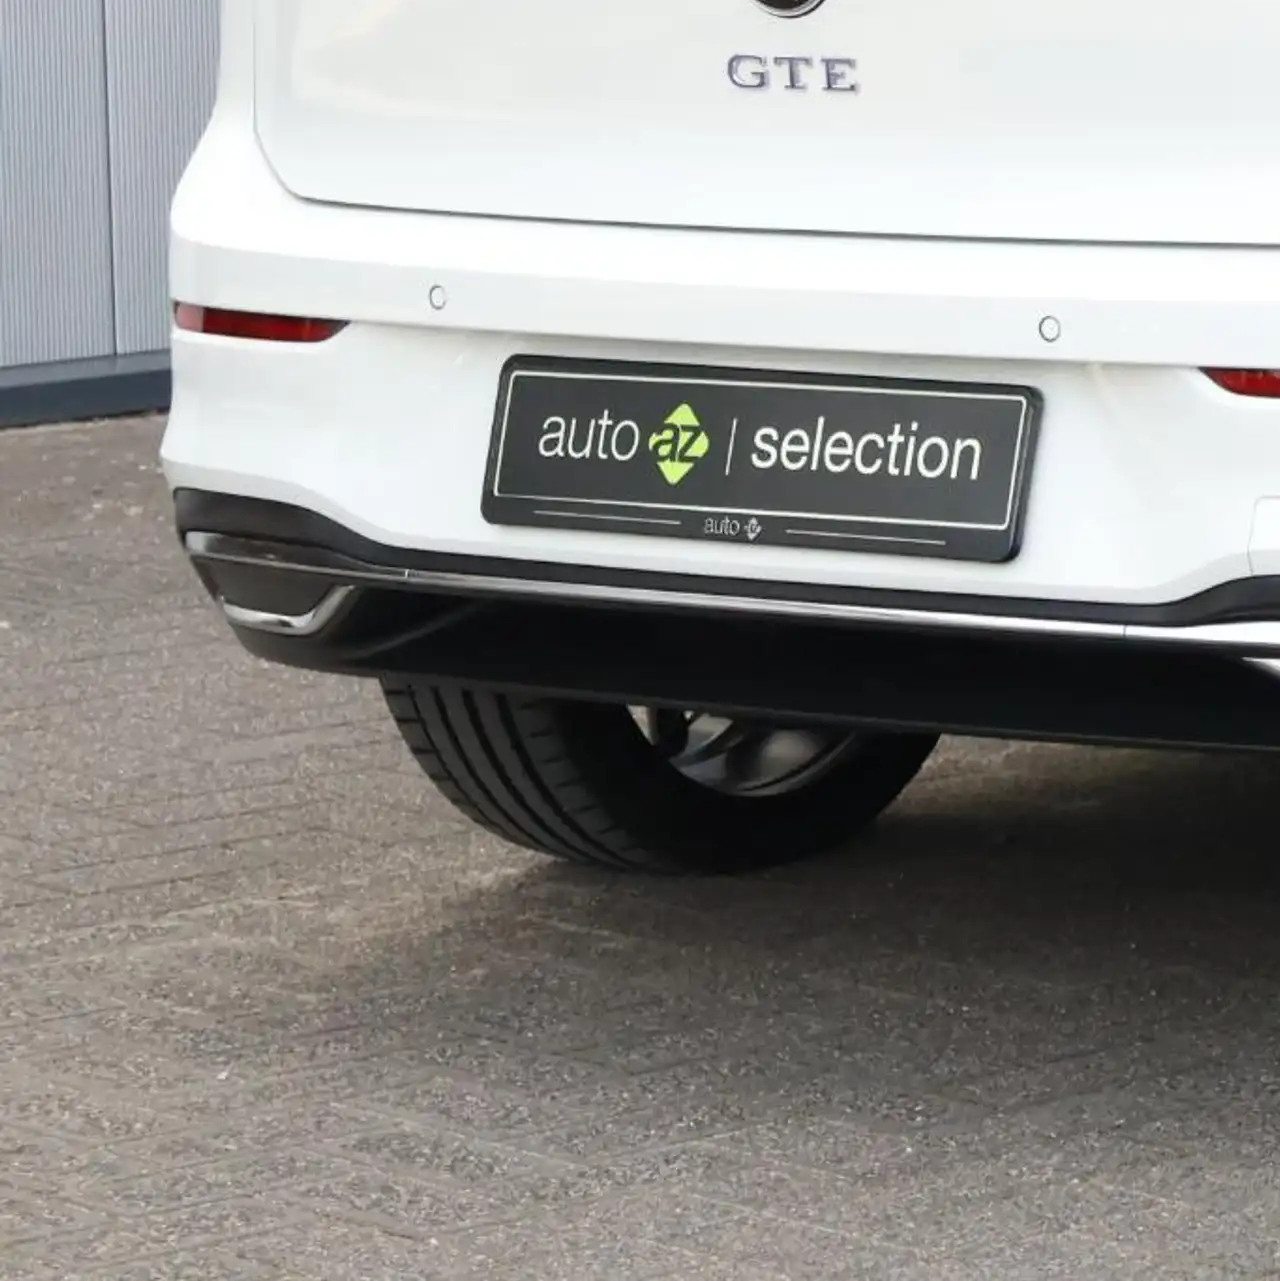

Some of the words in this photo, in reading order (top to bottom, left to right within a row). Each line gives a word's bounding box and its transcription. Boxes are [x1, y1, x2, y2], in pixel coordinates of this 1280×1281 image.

[727, 54, 858, 91] GTE
[537, 409, 640, 461] auto
[653, 422, 703, 463] az
[750, 415, 982, 481] selection
[703, 515, 740, 536] auto
